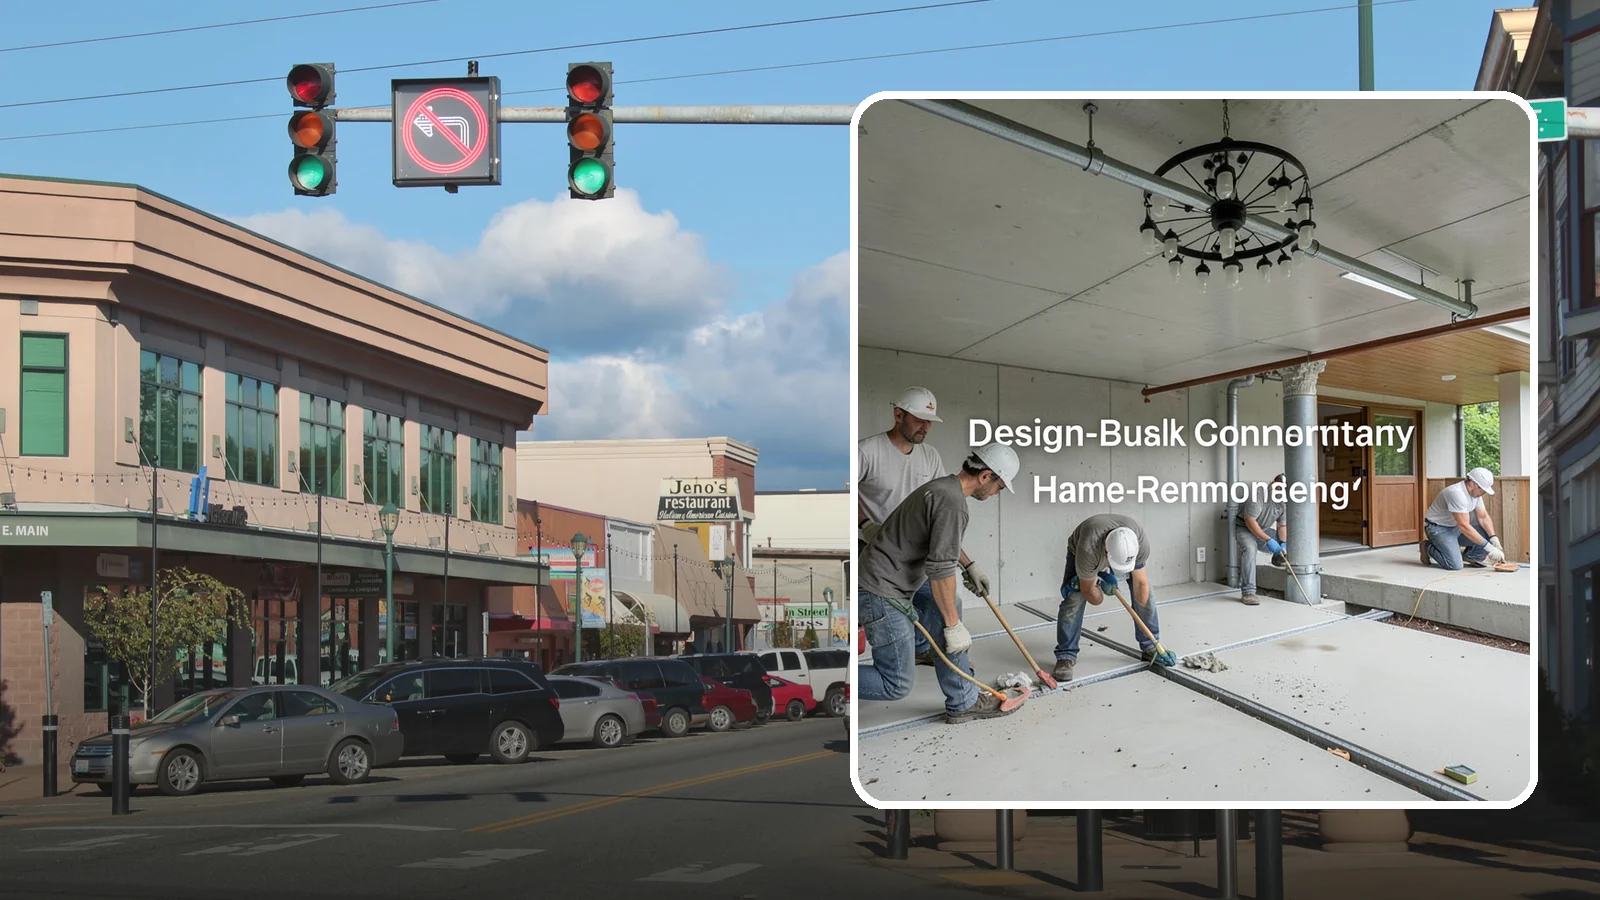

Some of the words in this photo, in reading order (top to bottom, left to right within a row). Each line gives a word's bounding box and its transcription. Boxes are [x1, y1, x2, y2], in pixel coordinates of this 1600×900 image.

[669, 480, 728, 494] Jeno's
[665, 496, 731, 509] restaurant
[686, 510, 715, 519] American
[715, 509, 737, 519] Cuisine
[2, 525, 13, 536] E.
[15, 525, 49, 536] MAIN
[797, 607, 828, 616] Street
